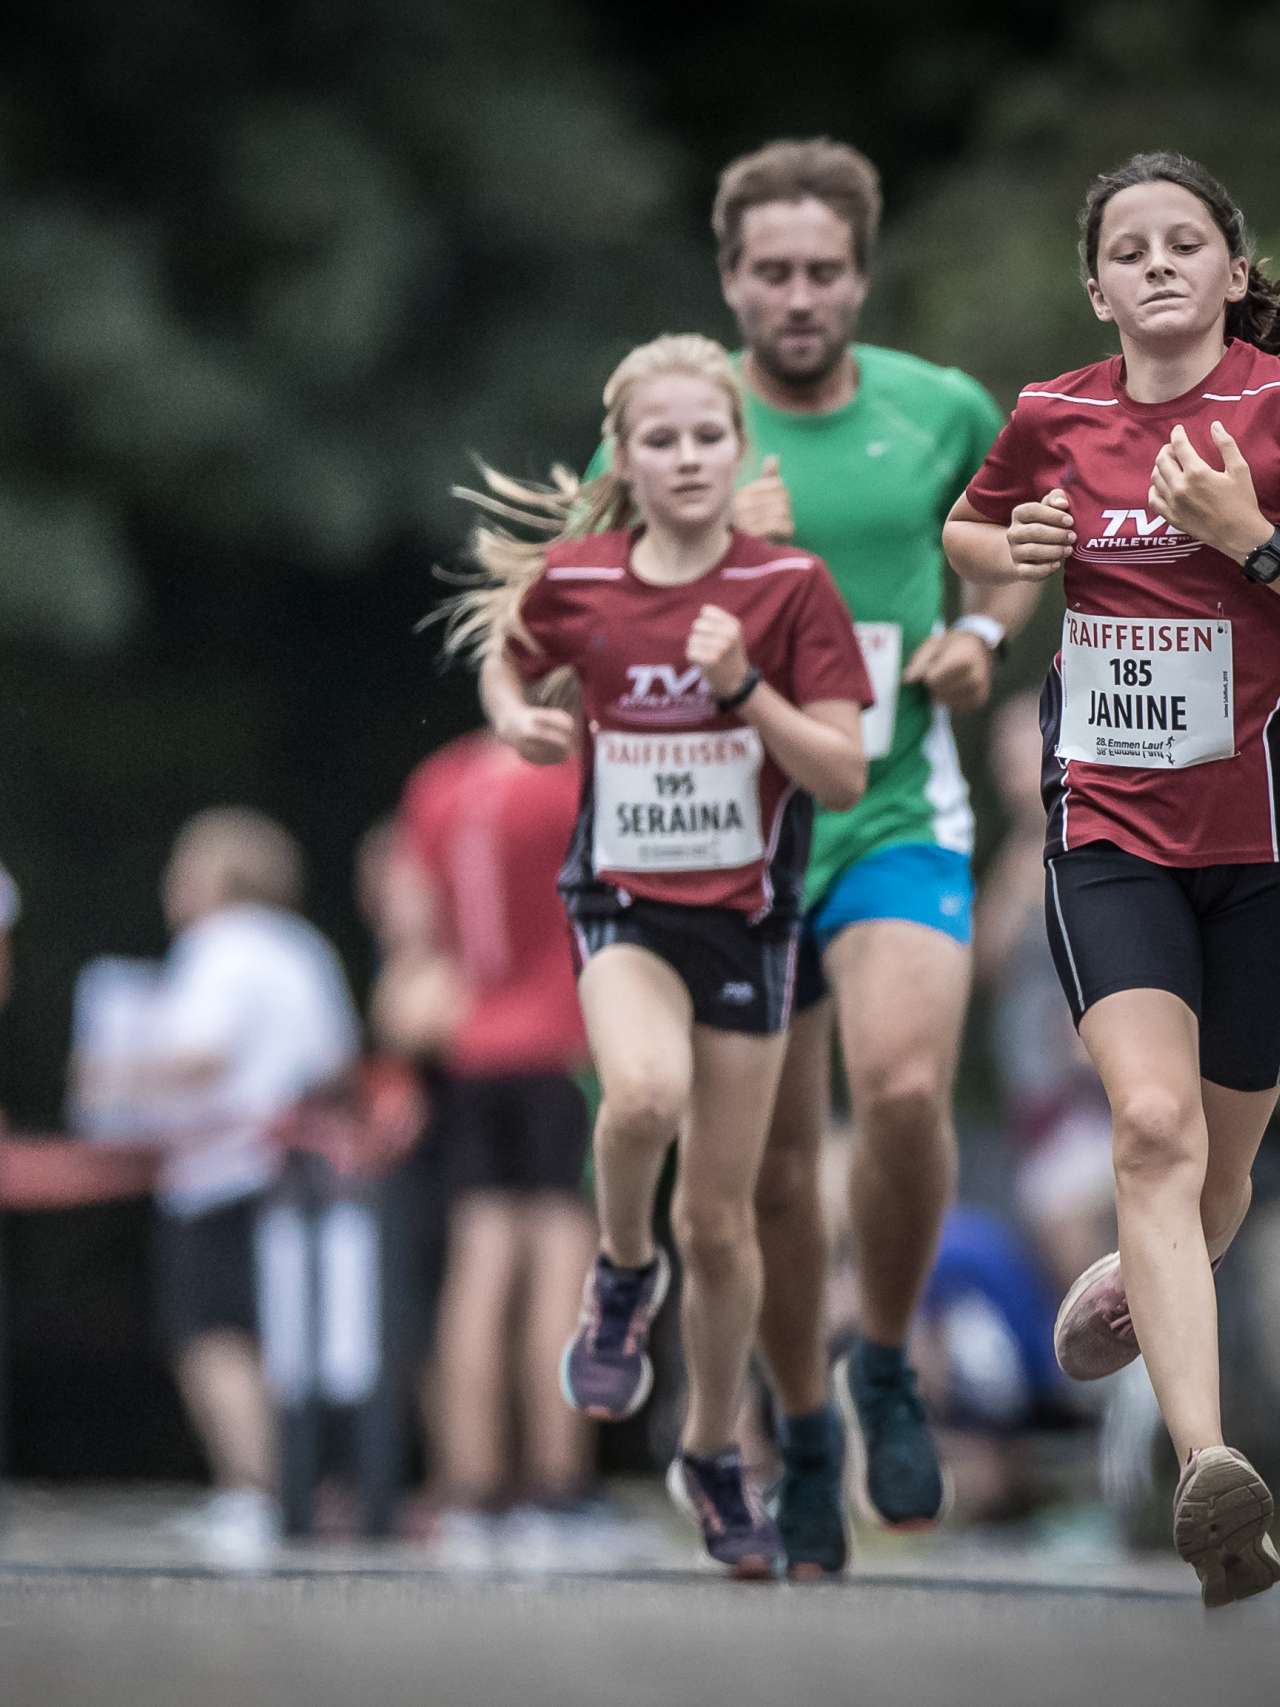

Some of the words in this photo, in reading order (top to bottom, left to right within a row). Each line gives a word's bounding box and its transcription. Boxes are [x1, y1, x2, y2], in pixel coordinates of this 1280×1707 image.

[1086, 536, 1178, 548] ATHLETICS
[1069, 620, 1212, 652] RAIFFEISEN
[1109, 658, 1152, 686] 185
[1088, 690, 1187, 731] JANINE
[1108, 738, 1140, 749] Emmen
[1142, 741, 1163, 750] Lauf
[655, 772, 695, 796] 195
[616, 801, 743, 836] SERAINA
